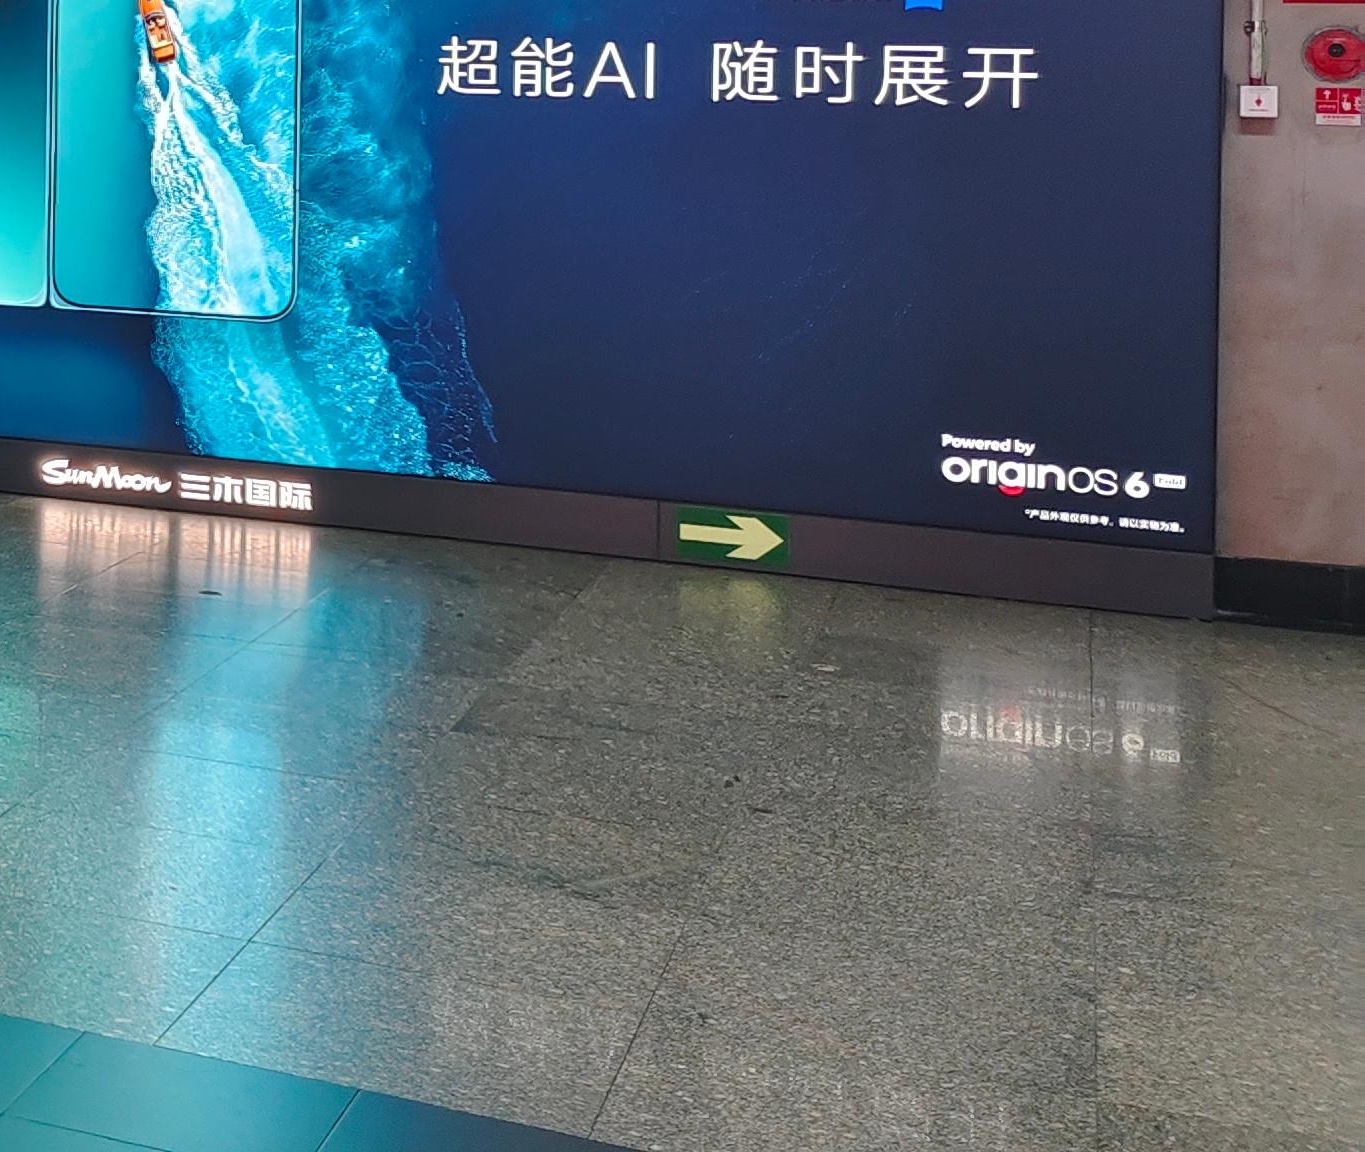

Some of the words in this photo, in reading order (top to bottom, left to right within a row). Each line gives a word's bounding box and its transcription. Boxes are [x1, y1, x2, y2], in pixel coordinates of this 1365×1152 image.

[437, 35, 655, 99] 超能AI
[712, 39, 1039, 109] 随时展开
[941, 433, 1012, 453] Powered
[1013, 439, 1036, 457] by
[180, 473, 312, 511] 三木国际
[1124, 471, 1150, 499] 6
